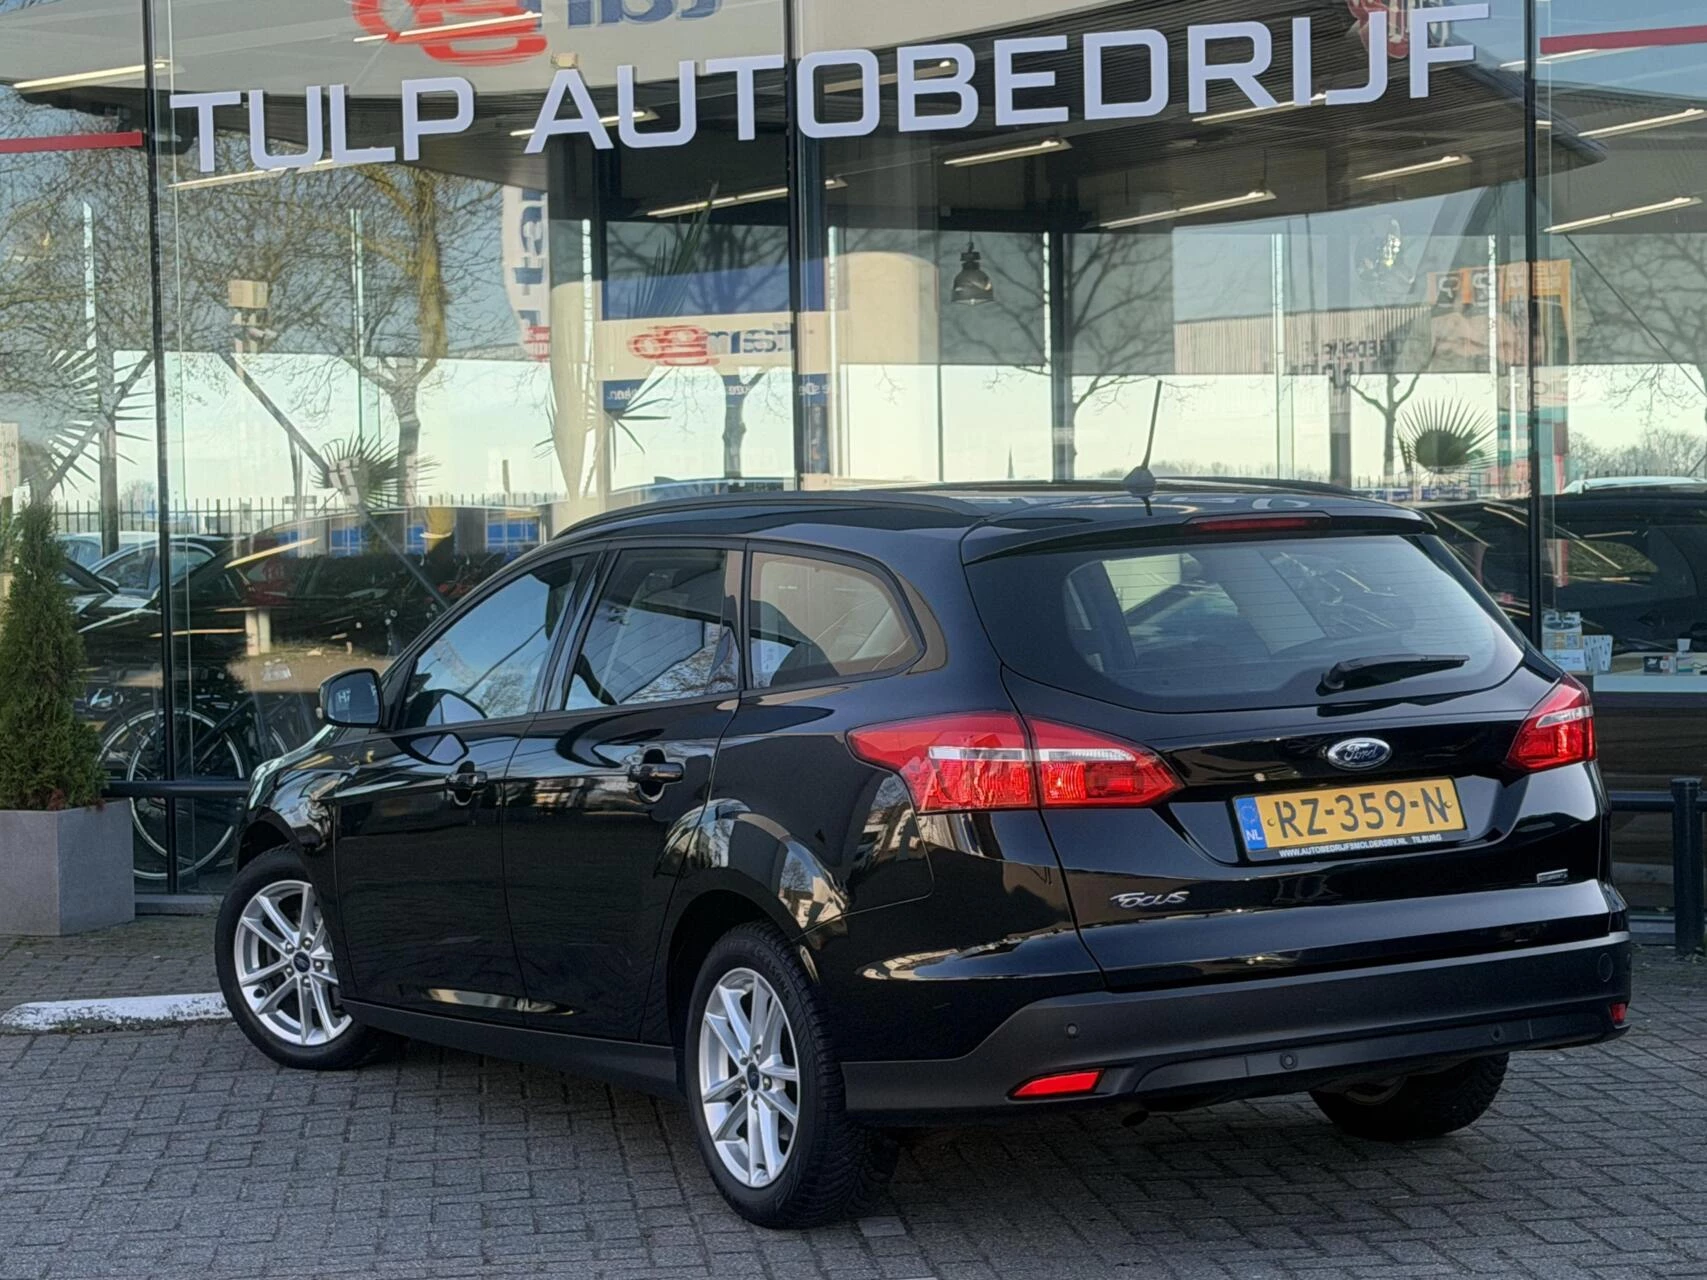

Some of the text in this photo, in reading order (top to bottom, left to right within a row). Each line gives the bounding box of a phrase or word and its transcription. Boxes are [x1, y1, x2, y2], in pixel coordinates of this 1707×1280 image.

[170, 77, 475, 172] TULP
[524, 3, 1490, 153] AUTOBEDRIJF
[1342, 742, 1378, 761] Ford
[1274, 787, 1449, 839] RZ-359-N
[1246, 829, 1263, 841] NL
[1412, 833, 1442, 844] TILBURG
